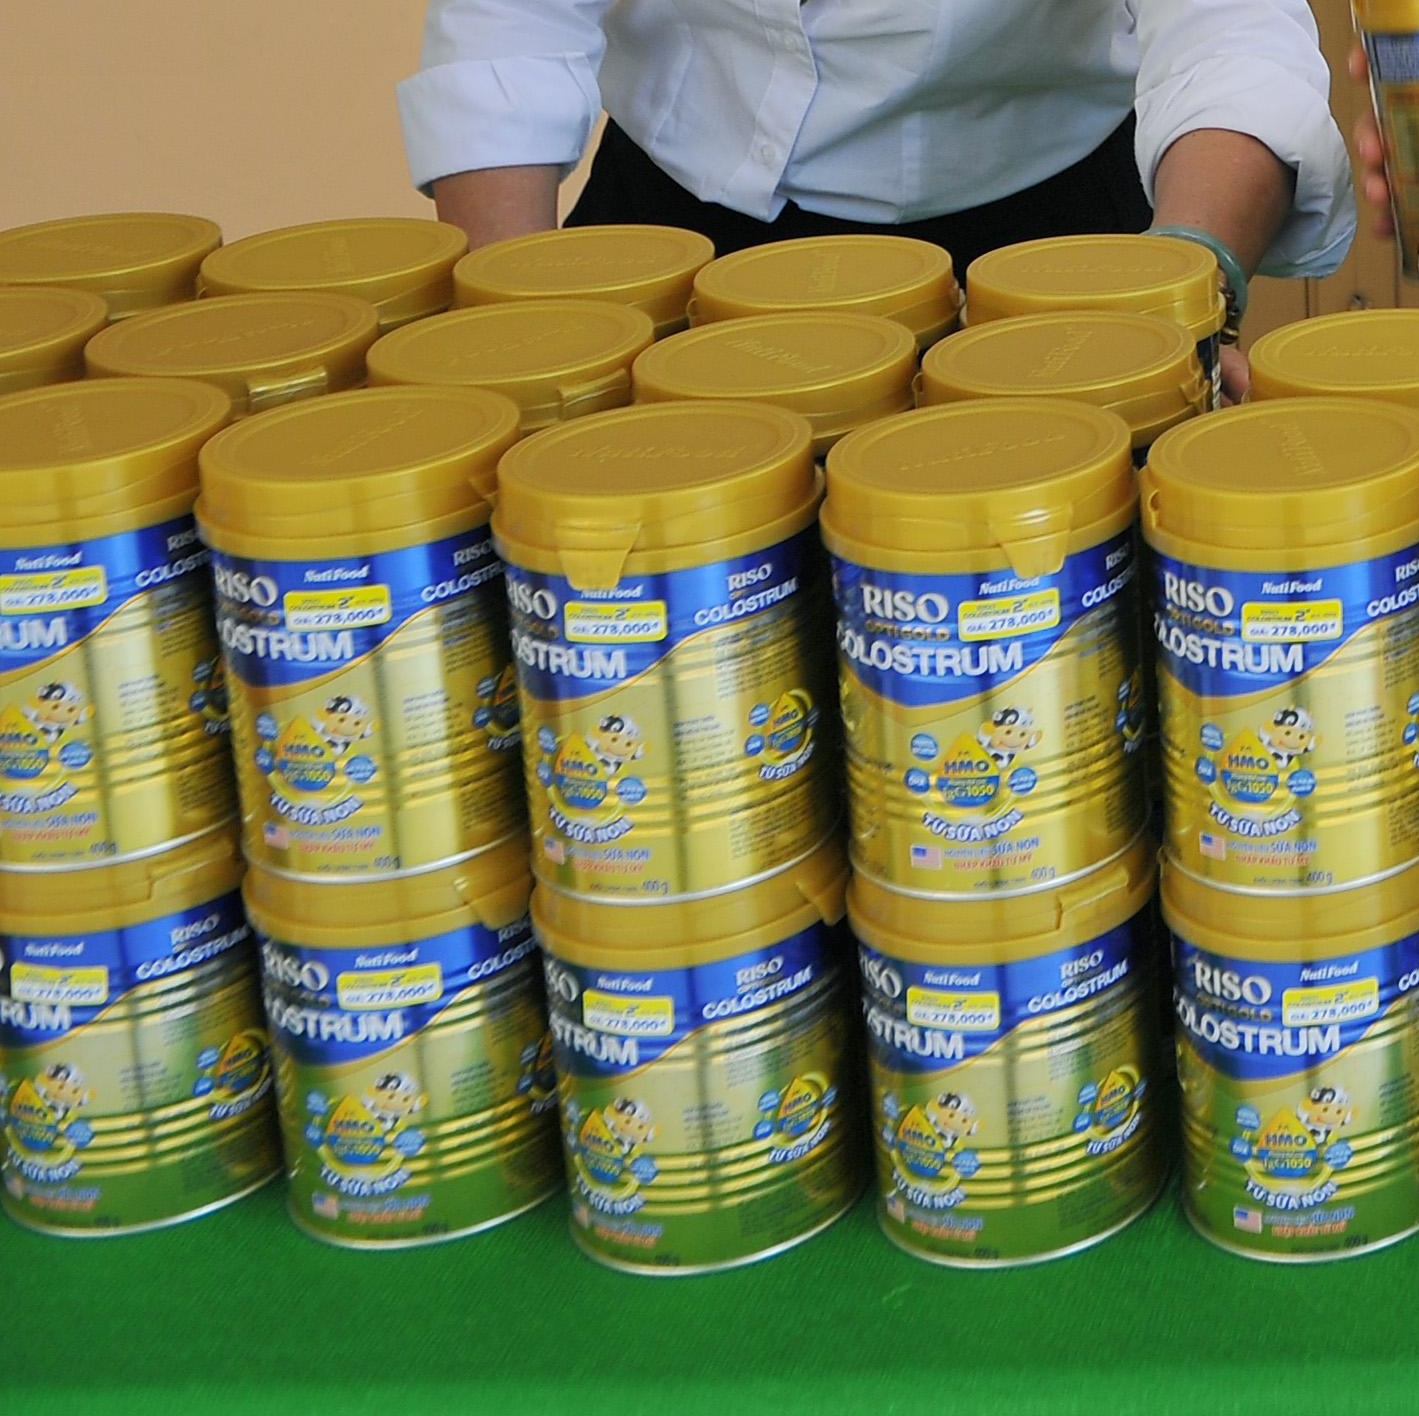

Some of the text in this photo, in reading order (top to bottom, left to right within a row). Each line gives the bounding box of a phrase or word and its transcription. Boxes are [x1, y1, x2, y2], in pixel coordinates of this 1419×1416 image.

[727, 563, 773, 591] RISO
[1164, 570, 1234, 617] RISO
[861, 584, 949, 623] RISO
[1060, 950, 1103, 979] RISO
[1192, 961, 1273, 1004] RISO
[1026, 960, 1129, 1014] COLOSTRUM
